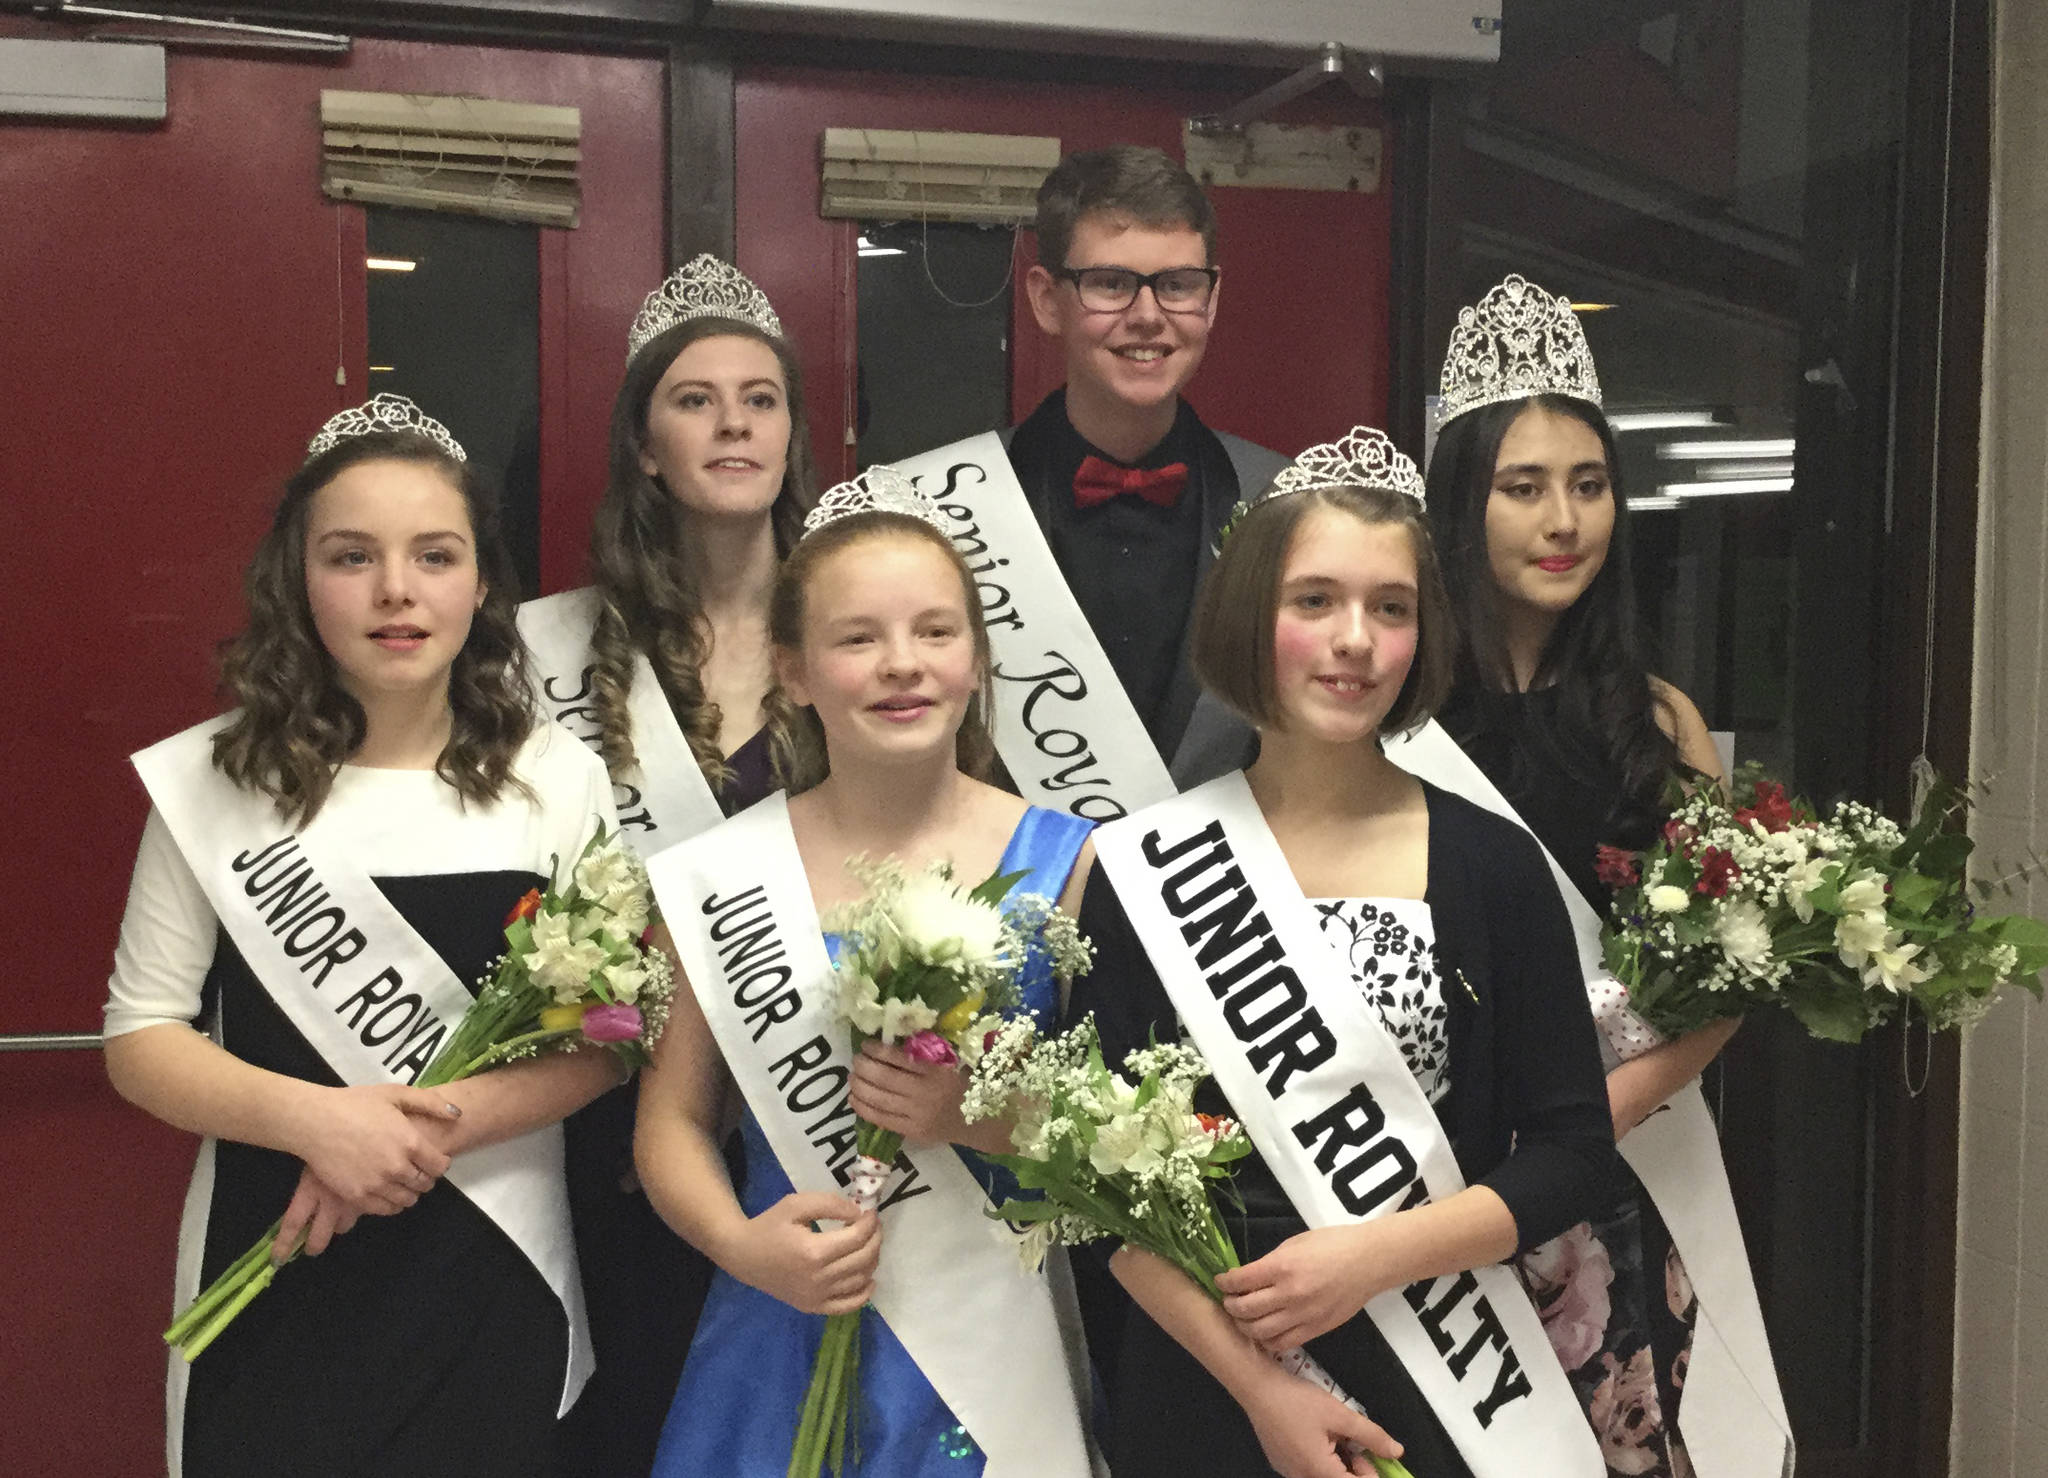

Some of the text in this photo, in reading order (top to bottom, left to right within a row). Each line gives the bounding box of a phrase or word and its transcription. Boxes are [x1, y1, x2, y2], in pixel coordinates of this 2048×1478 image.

[231, 835, 368, 989] JUNIOR
[701, 885, 803, 1043] JUNIOR
[1141, 818, 1533, 1431] JUNIOR ROLTY
